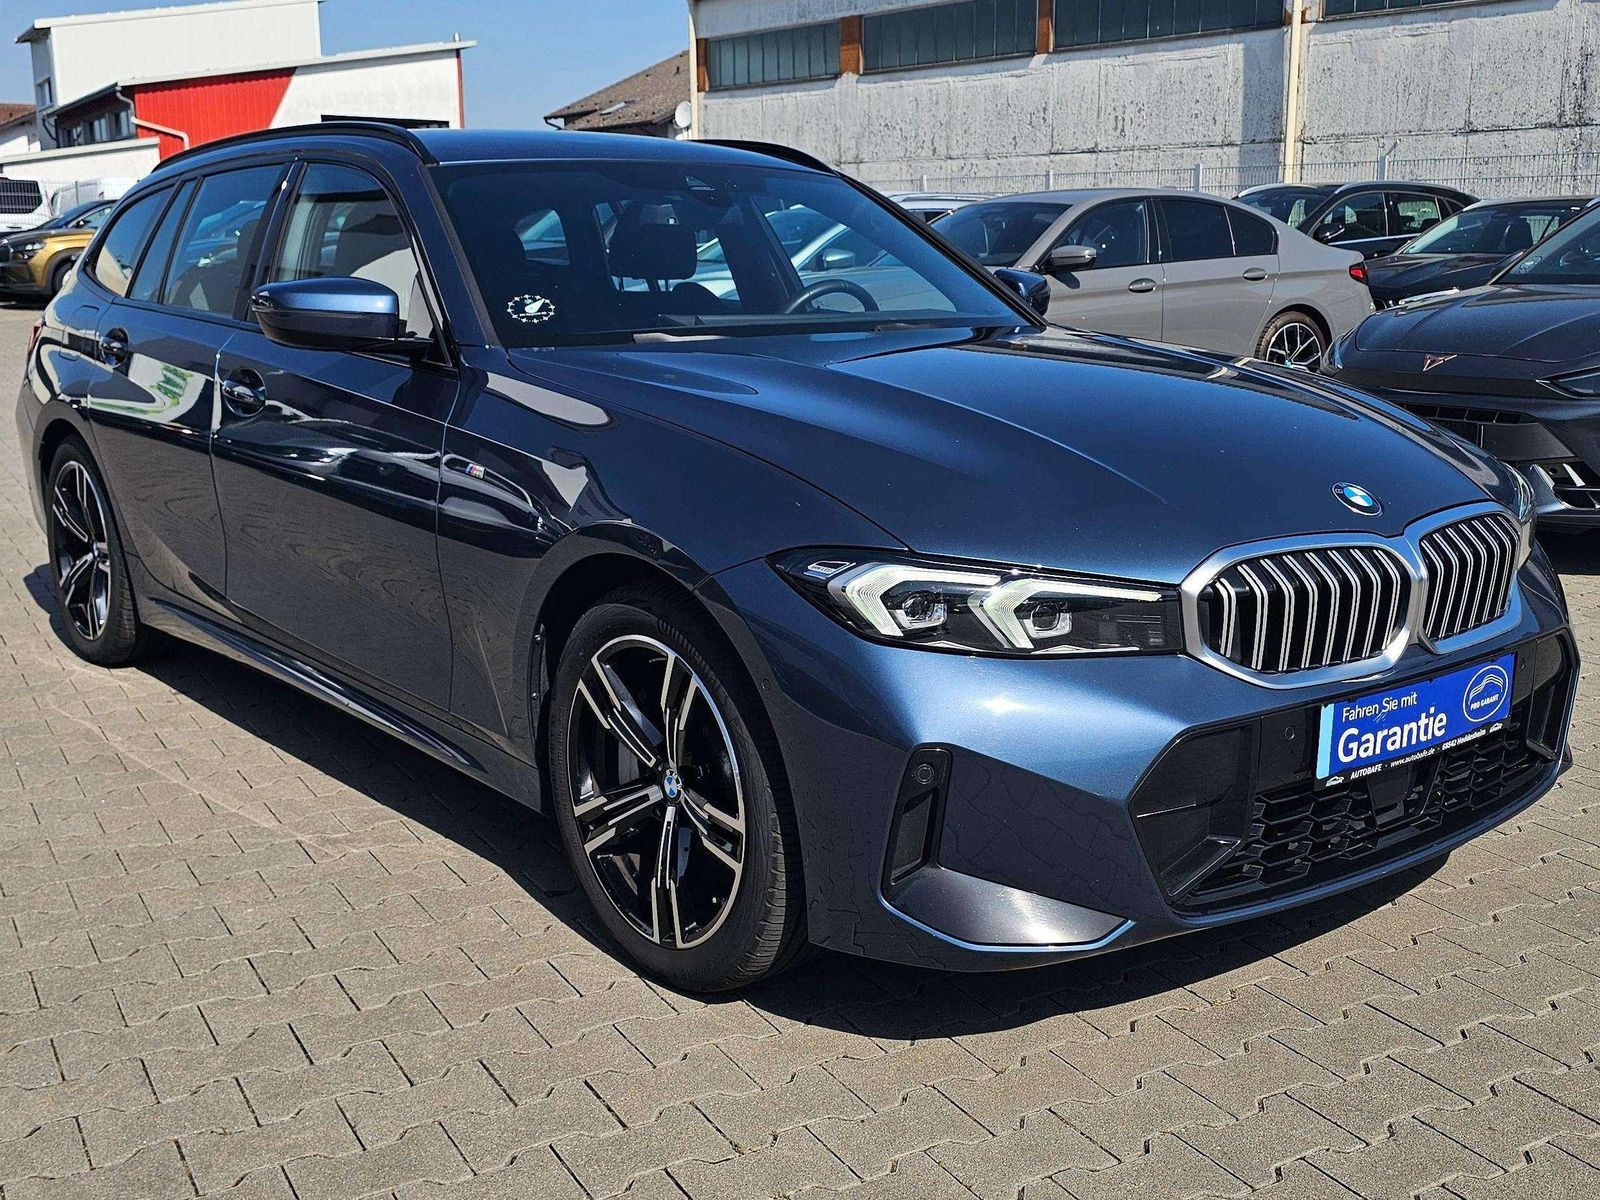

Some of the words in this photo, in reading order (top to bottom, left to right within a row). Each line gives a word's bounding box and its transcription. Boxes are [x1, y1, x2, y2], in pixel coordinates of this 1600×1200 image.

[1342, 703, 1379, 723] Fahren
[1382, 696, 1399, 713] Sie
[1401, 691, 1418, 708] mit
[1337, 706, 1448, 763] Garantie
[1350, 763, 1383, 780] AUTOBAFE
[1390, 747, 1436, 768] www.autobafe.de
